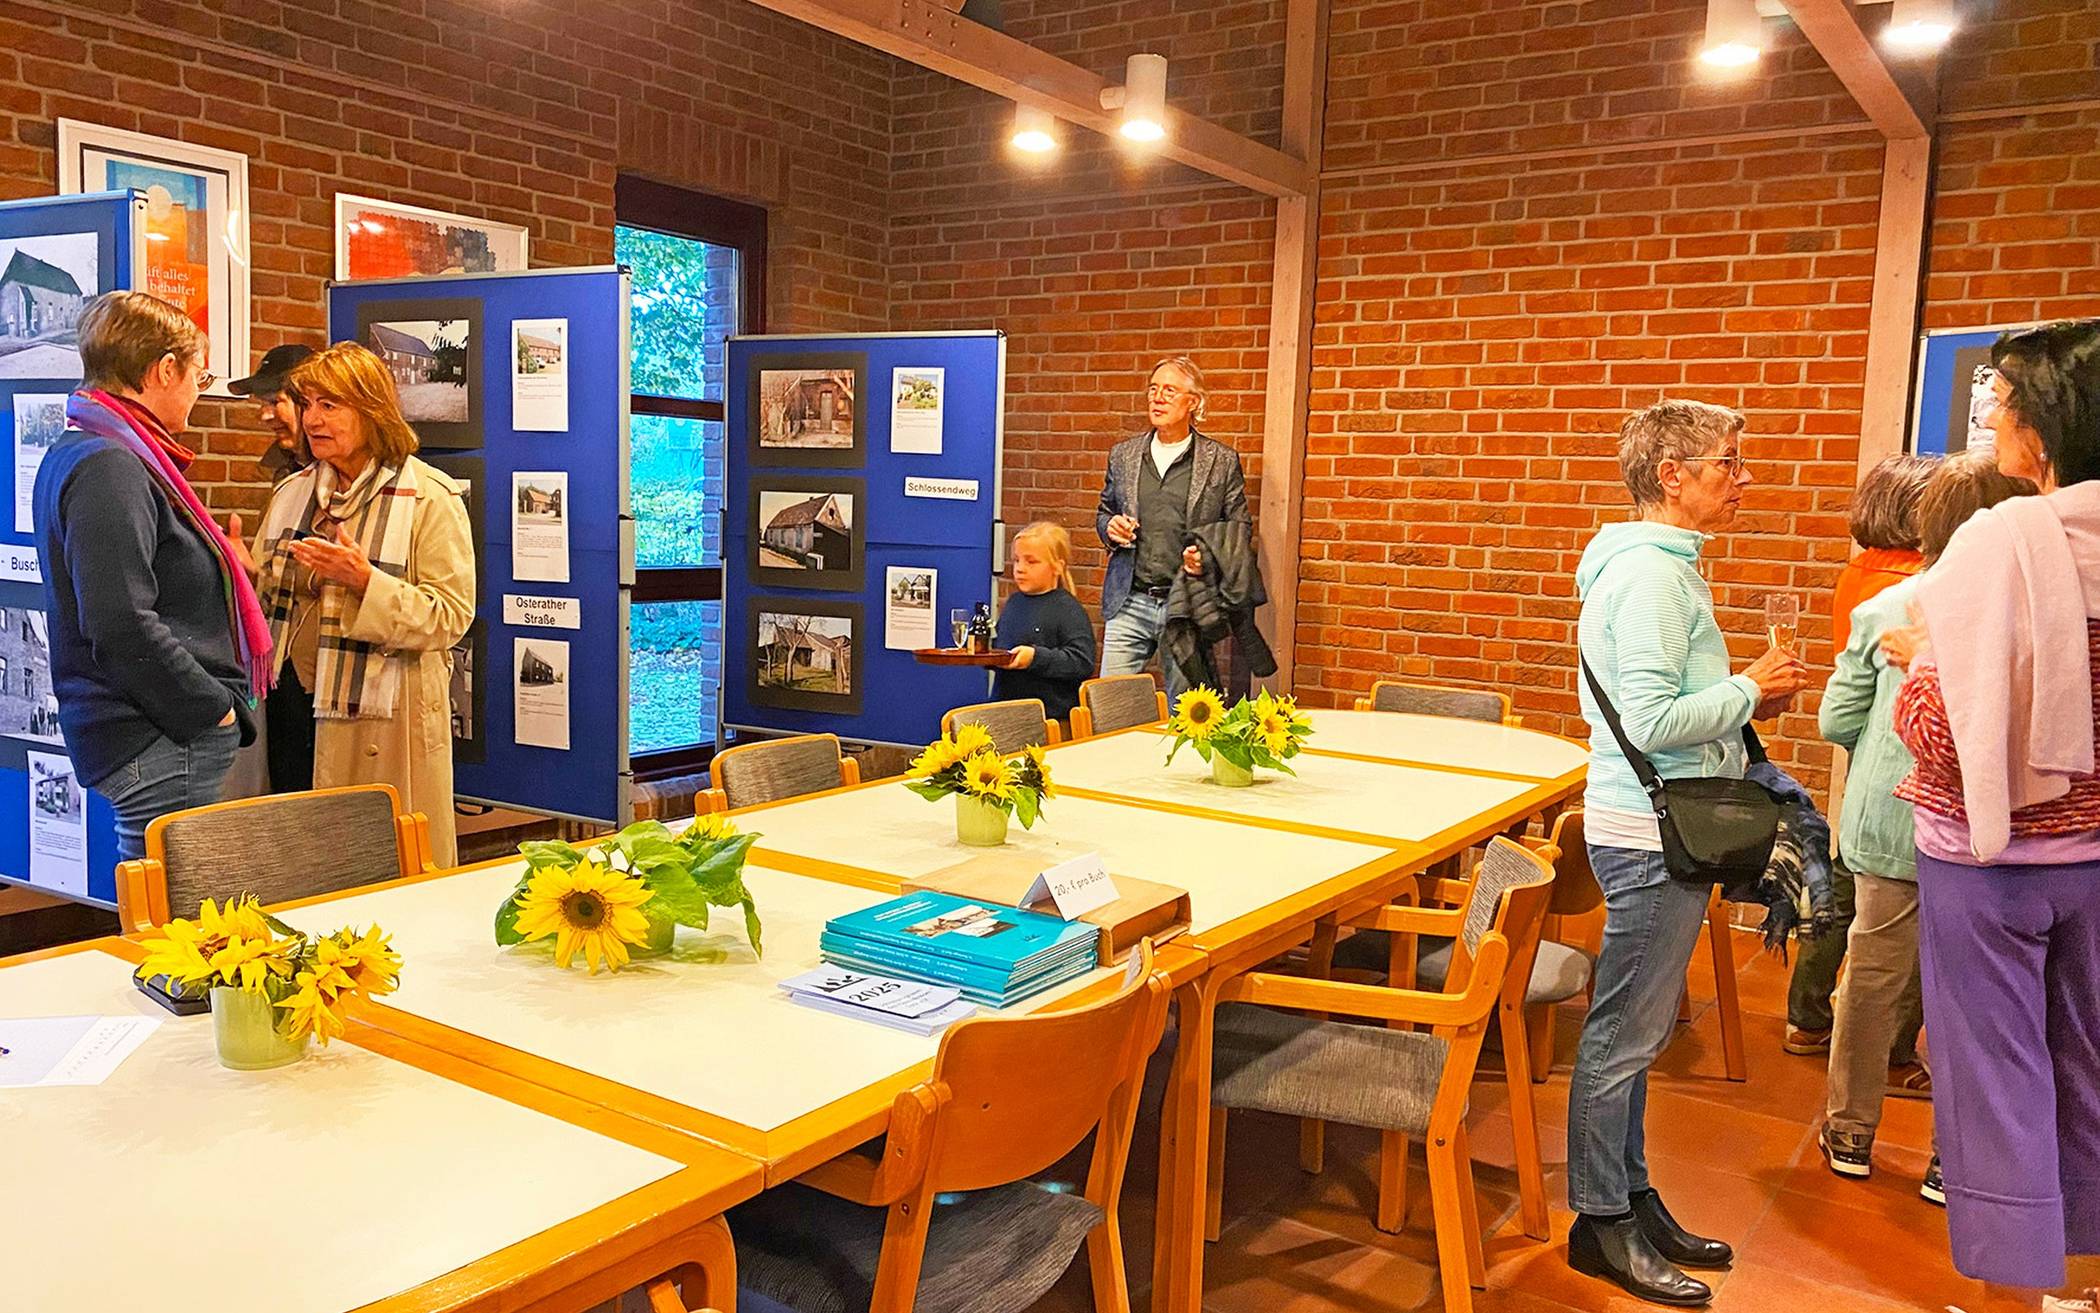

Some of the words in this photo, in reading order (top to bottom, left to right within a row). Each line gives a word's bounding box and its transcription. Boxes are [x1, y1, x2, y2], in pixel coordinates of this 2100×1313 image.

[162, 268, 189, 281] alles
[908, 482, 976, 498] Schlossendweg
[516, 596, 567, 609] Osterather
[524, 612, 556, 625] Straße
[849, 981, 901, 1002] 2025
